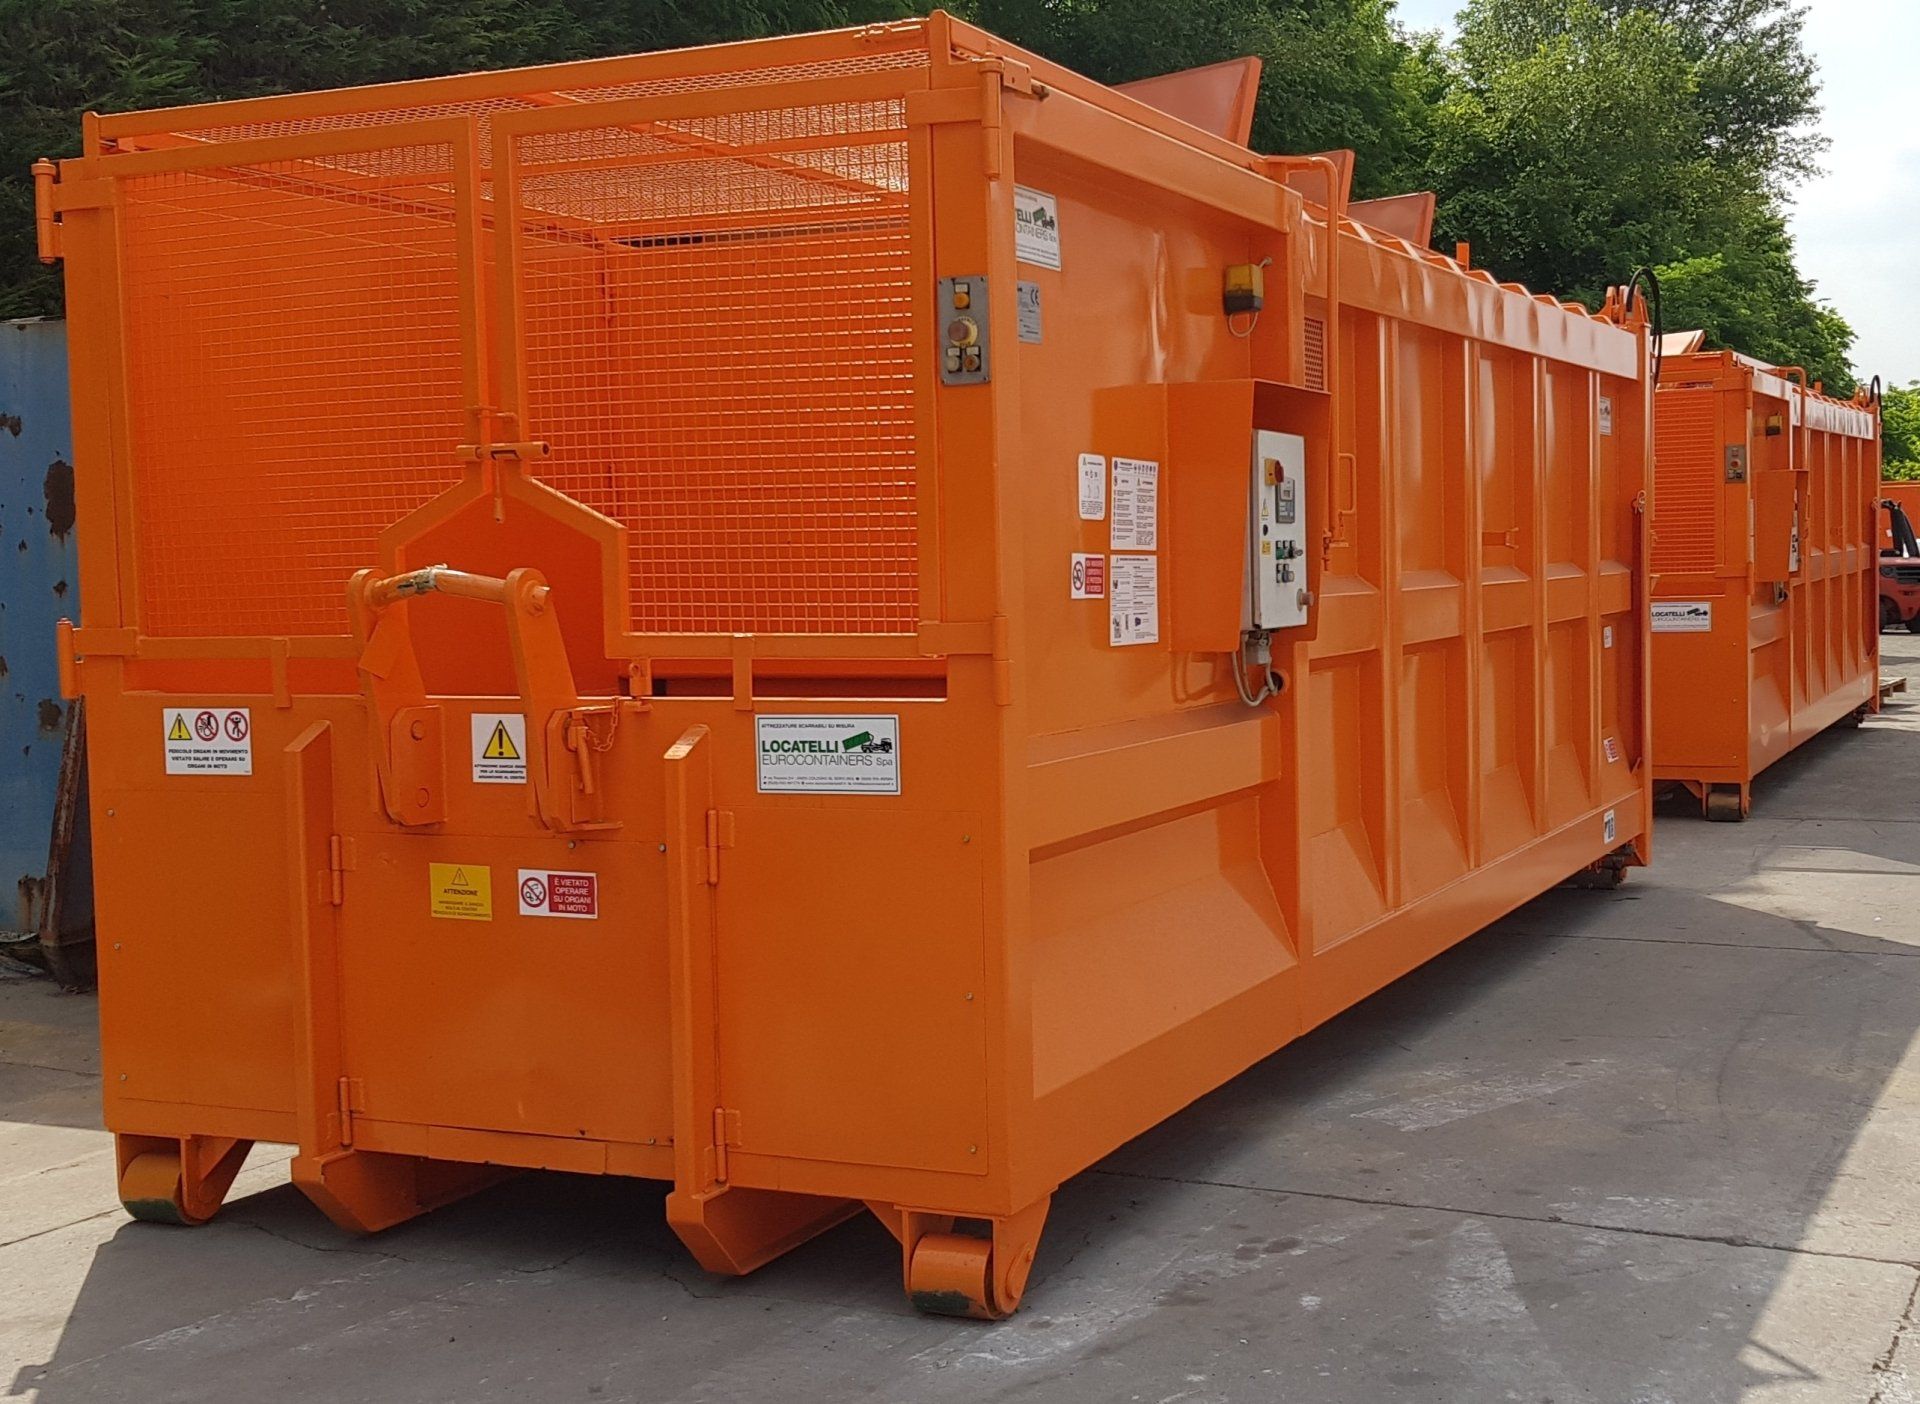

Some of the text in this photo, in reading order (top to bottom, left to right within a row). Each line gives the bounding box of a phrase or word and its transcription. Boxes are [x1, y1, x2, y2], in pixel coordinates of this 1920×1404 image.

[762, 740, 839, 753] LOCATELLI
[762, 754, 893, 767] EUROCONTAINERS Spa
[560, 879, 590, 887] VIETATO
[555, 886, 589, 895] OPERARE
[553, 895, 591, 904] SU ORGANI
[566, 904, 588, 912] MOTO
